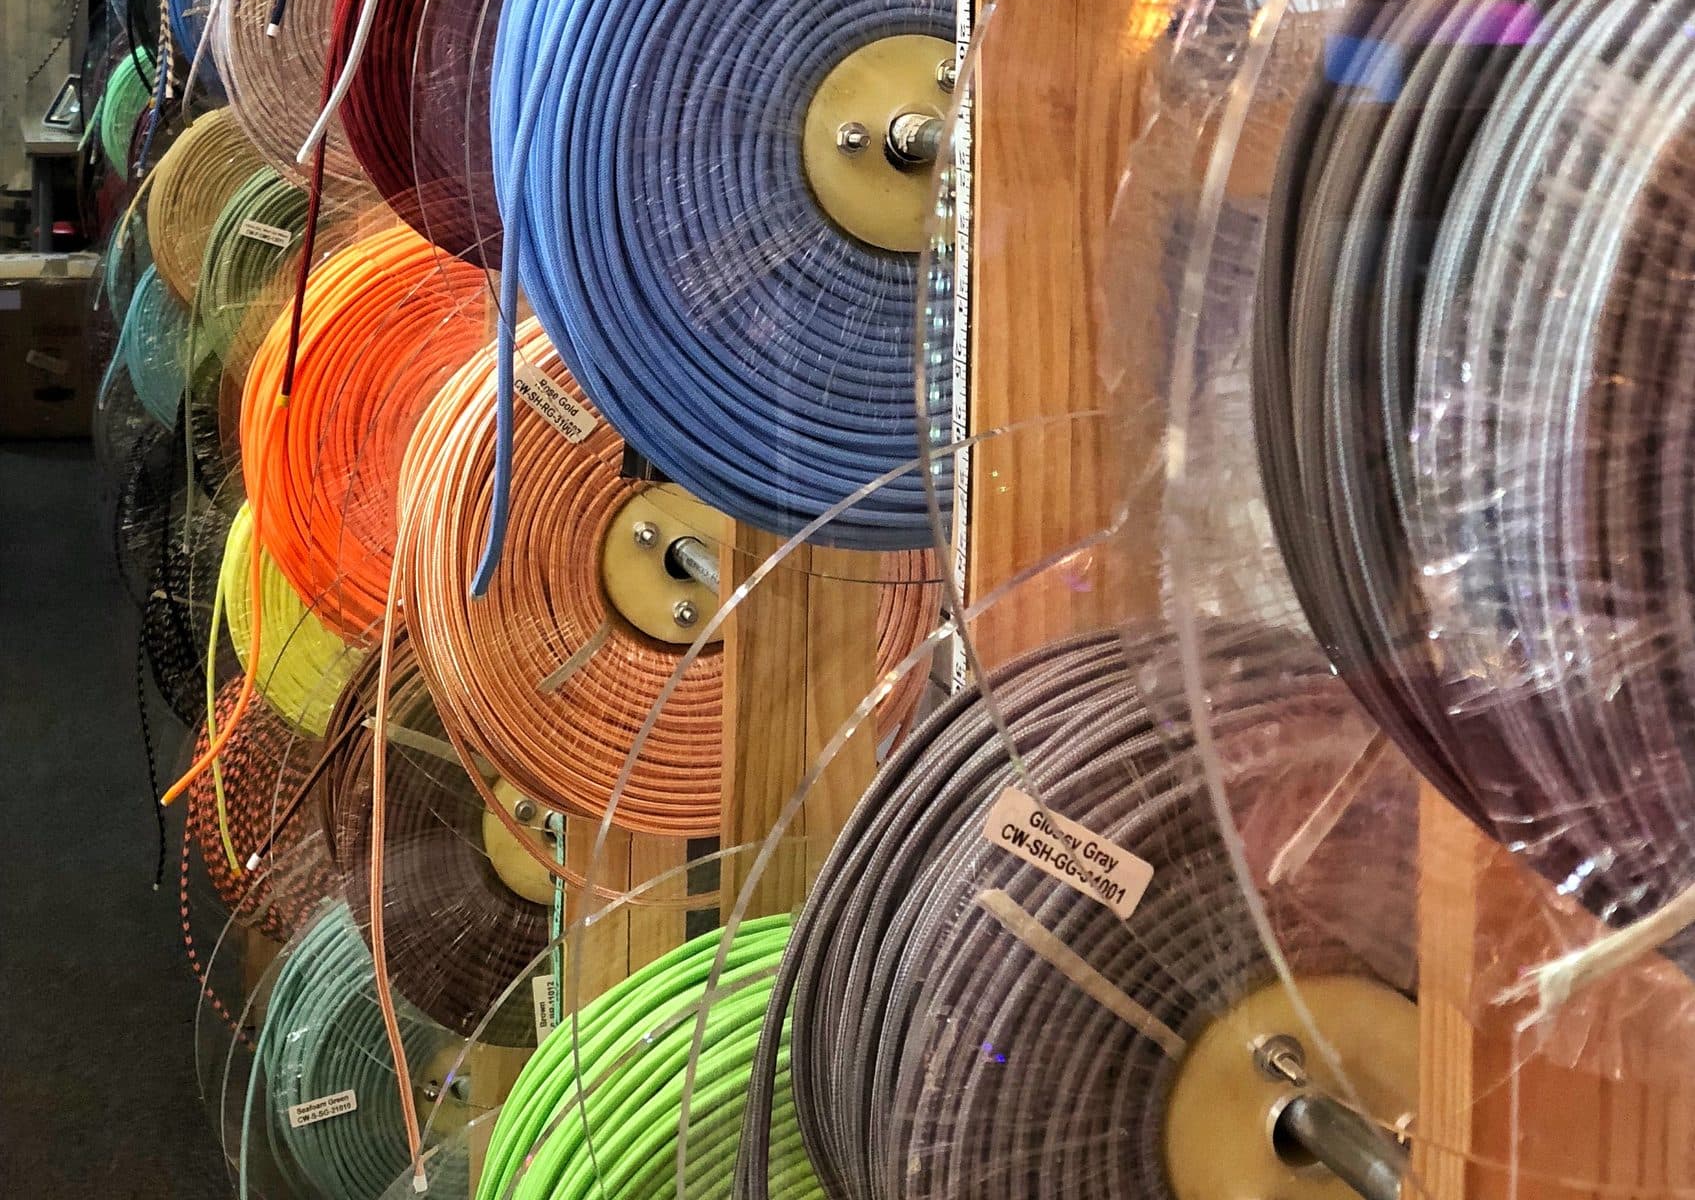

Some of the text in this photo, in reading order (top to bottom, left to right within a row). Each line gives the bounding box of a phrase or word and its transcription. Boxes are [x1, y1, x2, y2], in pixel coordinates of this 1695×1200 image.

[539, 379, 579, 417] Rose Gold
[1082, 841, 1119, 874] Gray
[539, 1001, 547, 1028] Brown
[296, 1095, 350, 1115] Seafoam Green
